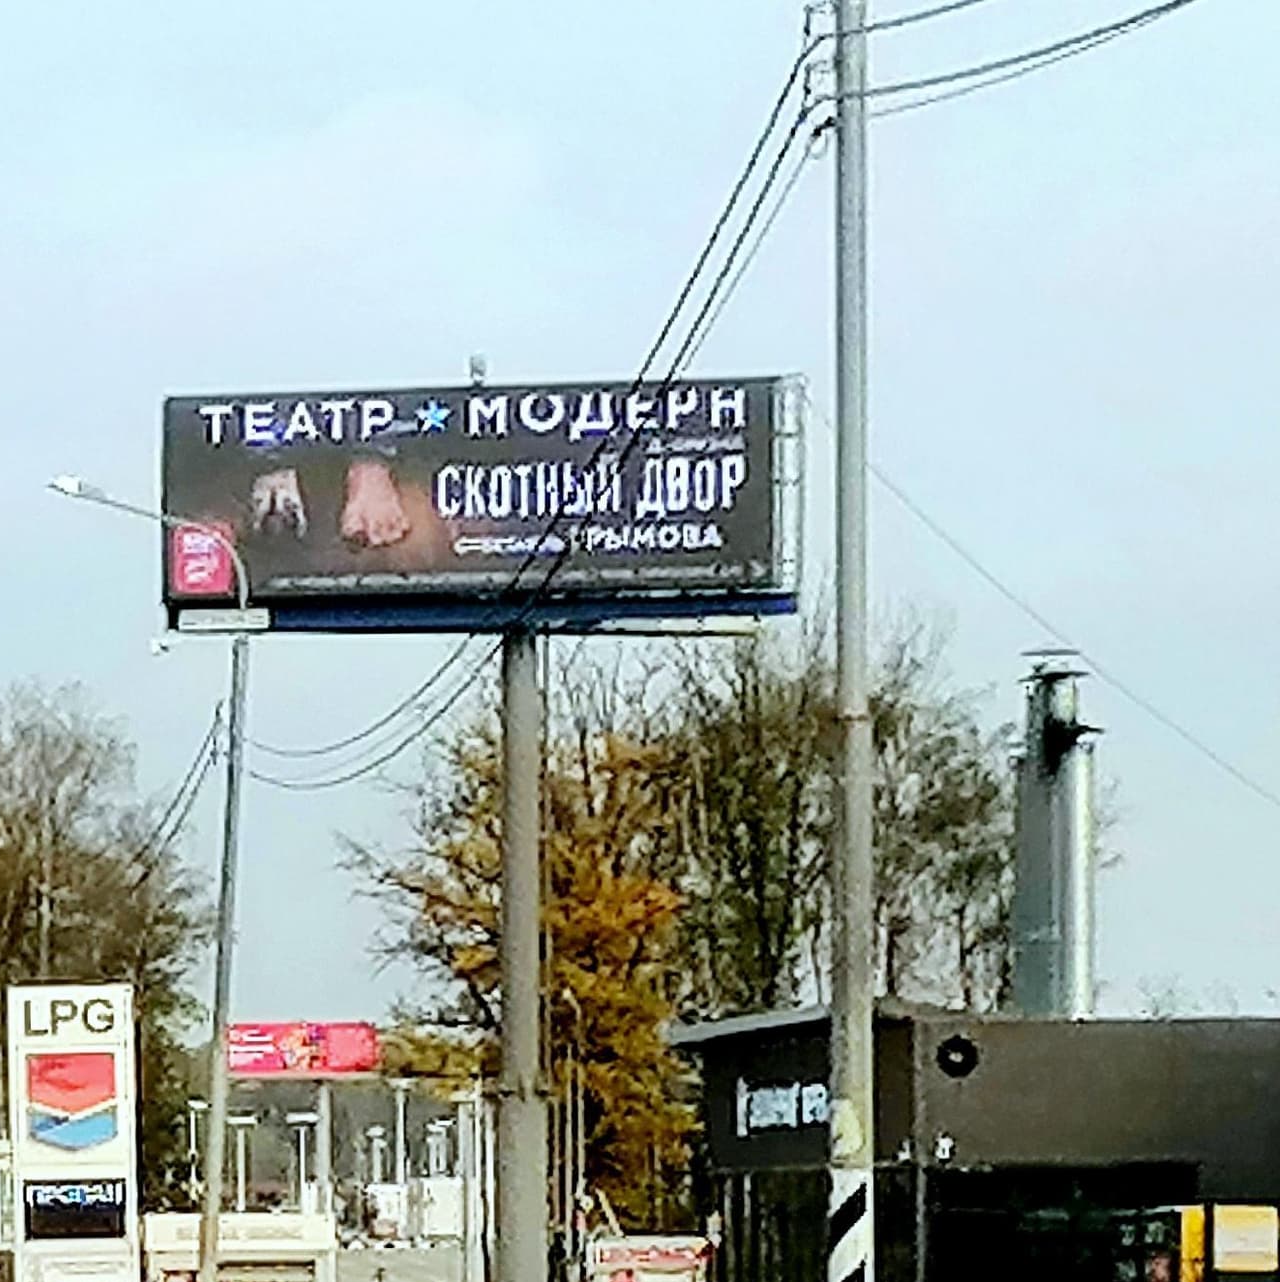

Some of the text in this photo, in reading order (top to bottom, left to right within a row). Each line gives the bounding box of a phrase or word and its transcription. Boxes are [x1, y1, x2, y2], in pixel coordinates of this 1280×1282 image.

[199, 388, 746, 443] ТЕАТР МОДЕРН
[437, 453, 743, 518] СКОТНЫЙ ДВОР
[24, 999, 113, 1036] LPG
